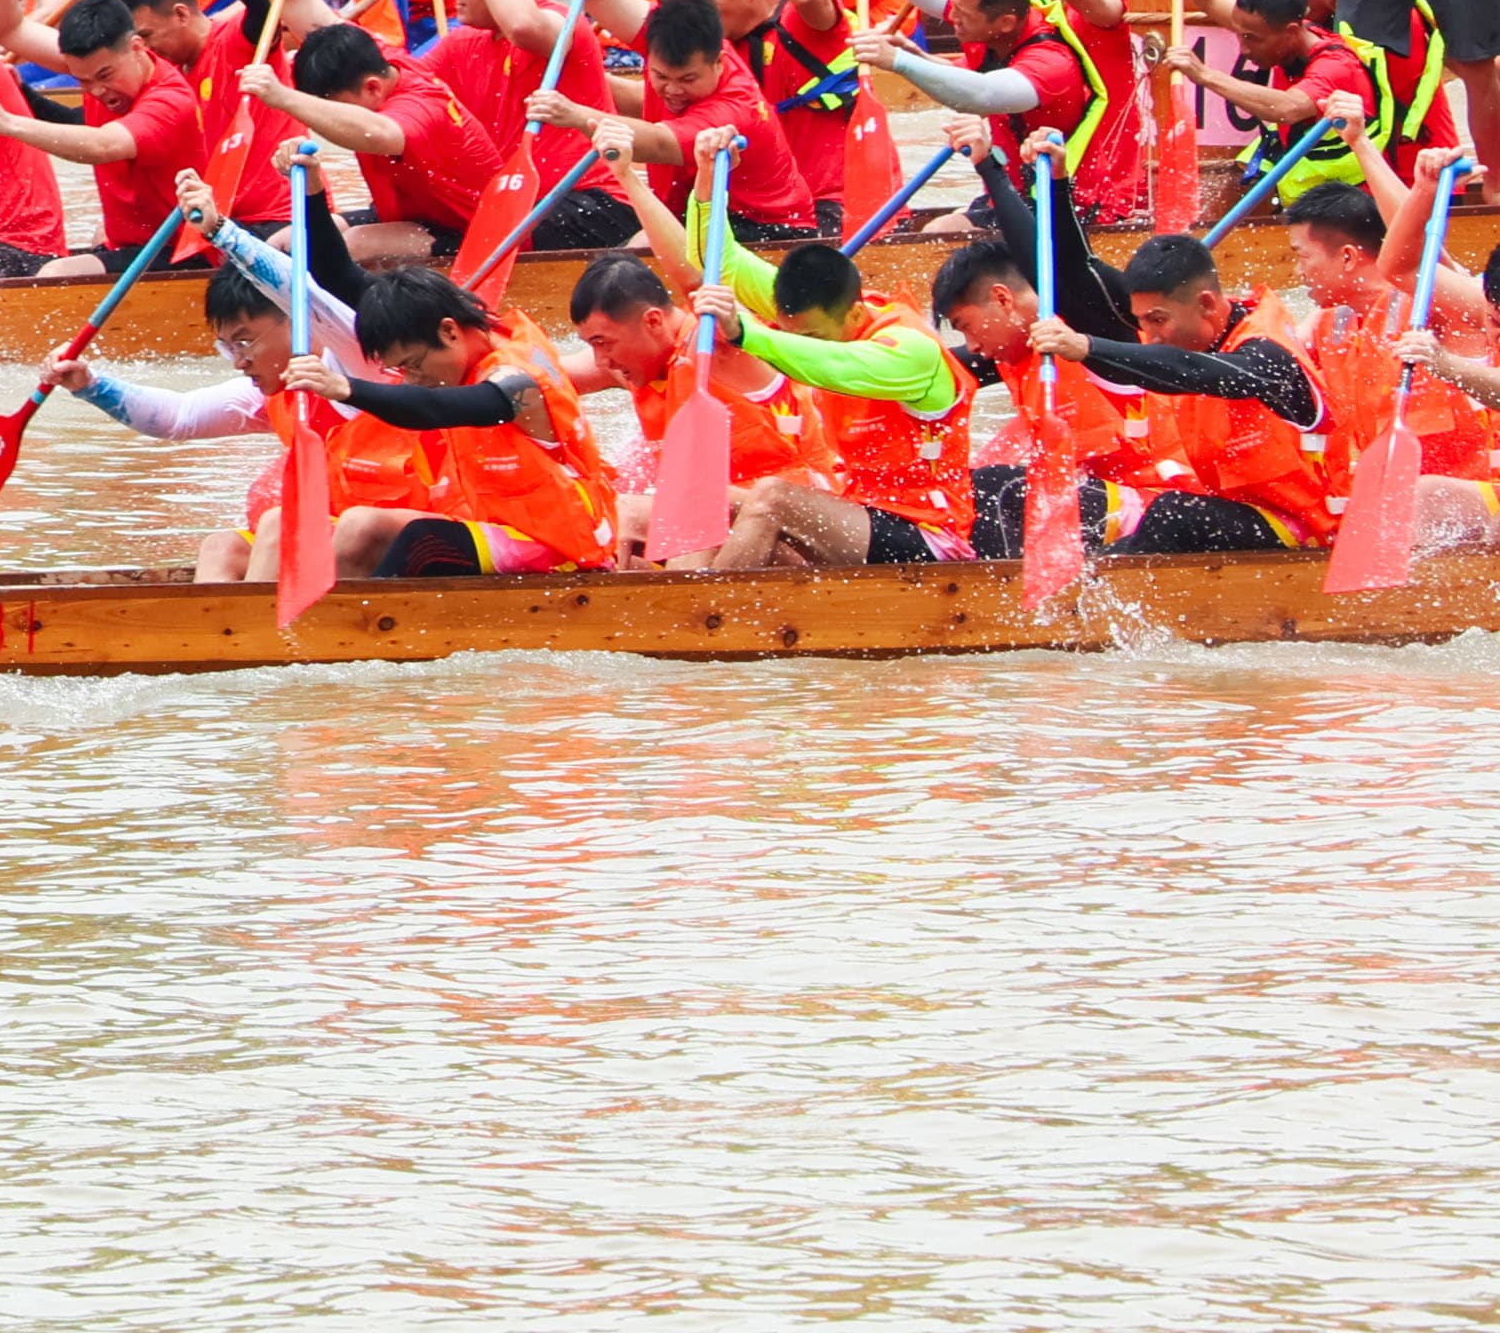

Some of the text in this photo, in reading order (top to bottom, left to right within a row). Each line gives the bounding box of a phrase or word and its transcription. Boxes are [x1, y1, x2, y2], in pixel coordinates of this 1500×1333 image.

[854, 117, 877, 141] 14
[221, 133, 243, 154] 13
[498, 173, 524, 191] 16
